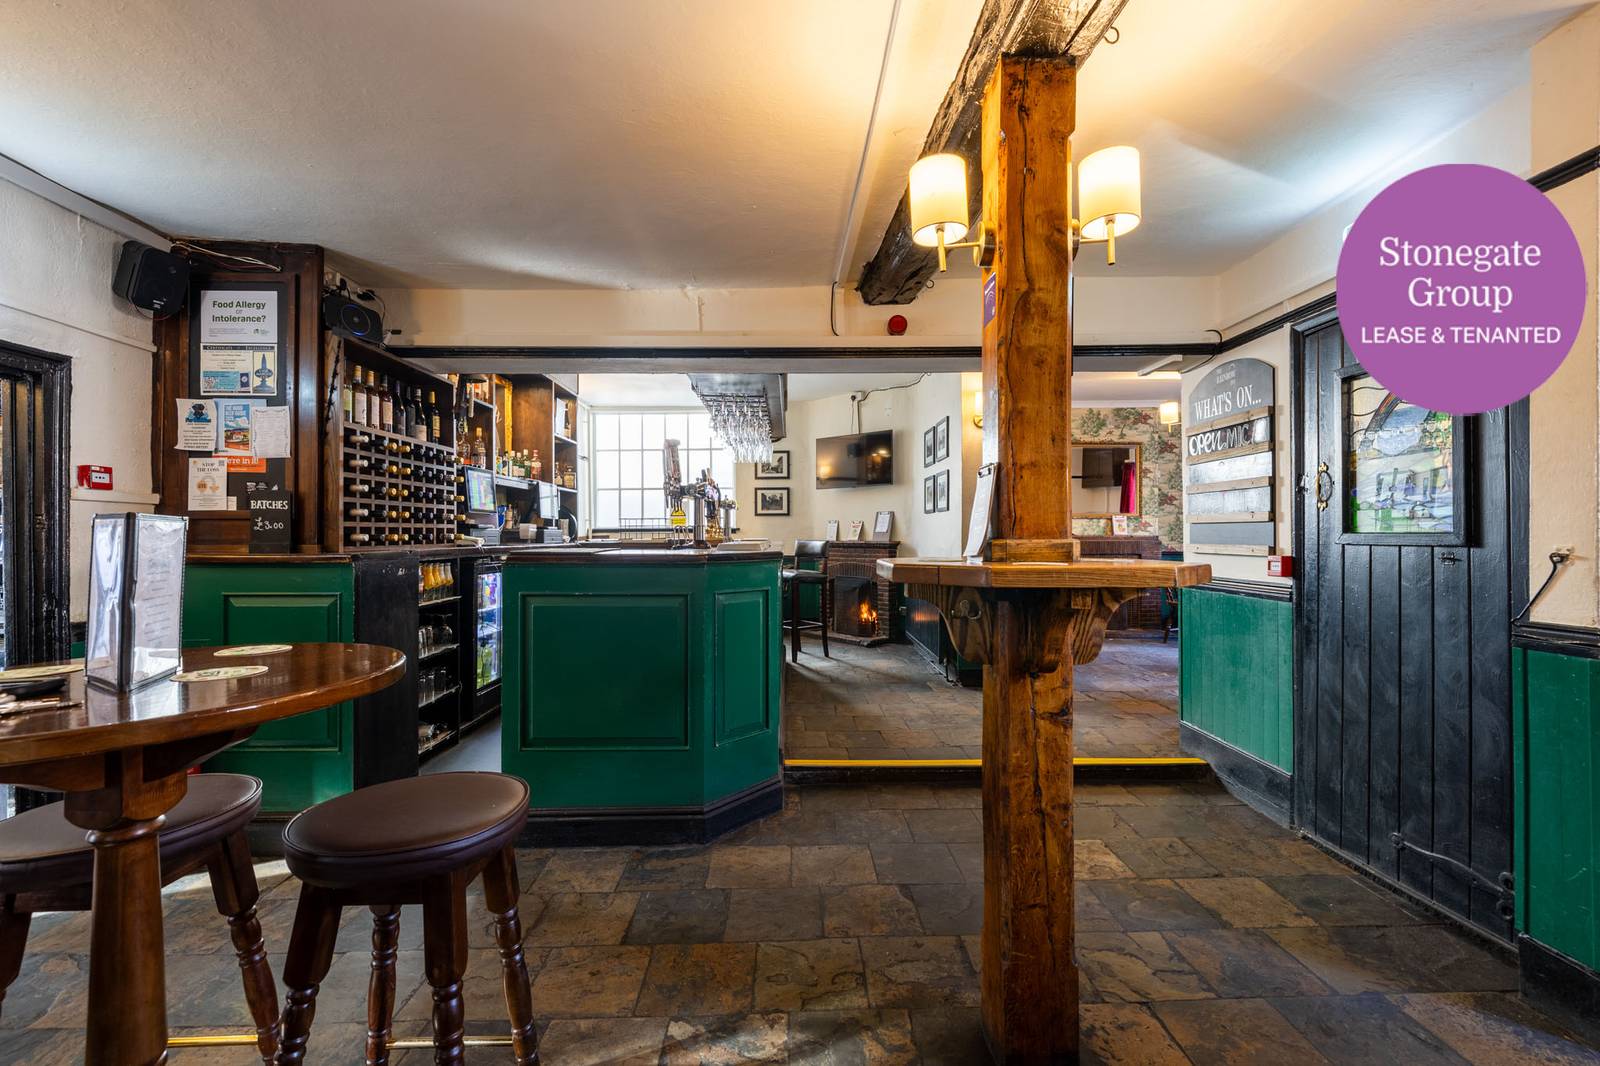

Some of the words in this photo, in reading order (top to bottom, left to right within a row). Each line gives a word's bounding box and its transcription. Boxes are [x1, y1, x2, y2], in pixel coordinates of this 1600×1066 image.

[235, 300, 266, 310] Allergy
[212, 315, 266, 323] Intolerance?
[1194, 391, 1232, 422] WHAT'S
[250, 500, 288, 510] BATCHES
[253, 516, 284, 531] £3.00
